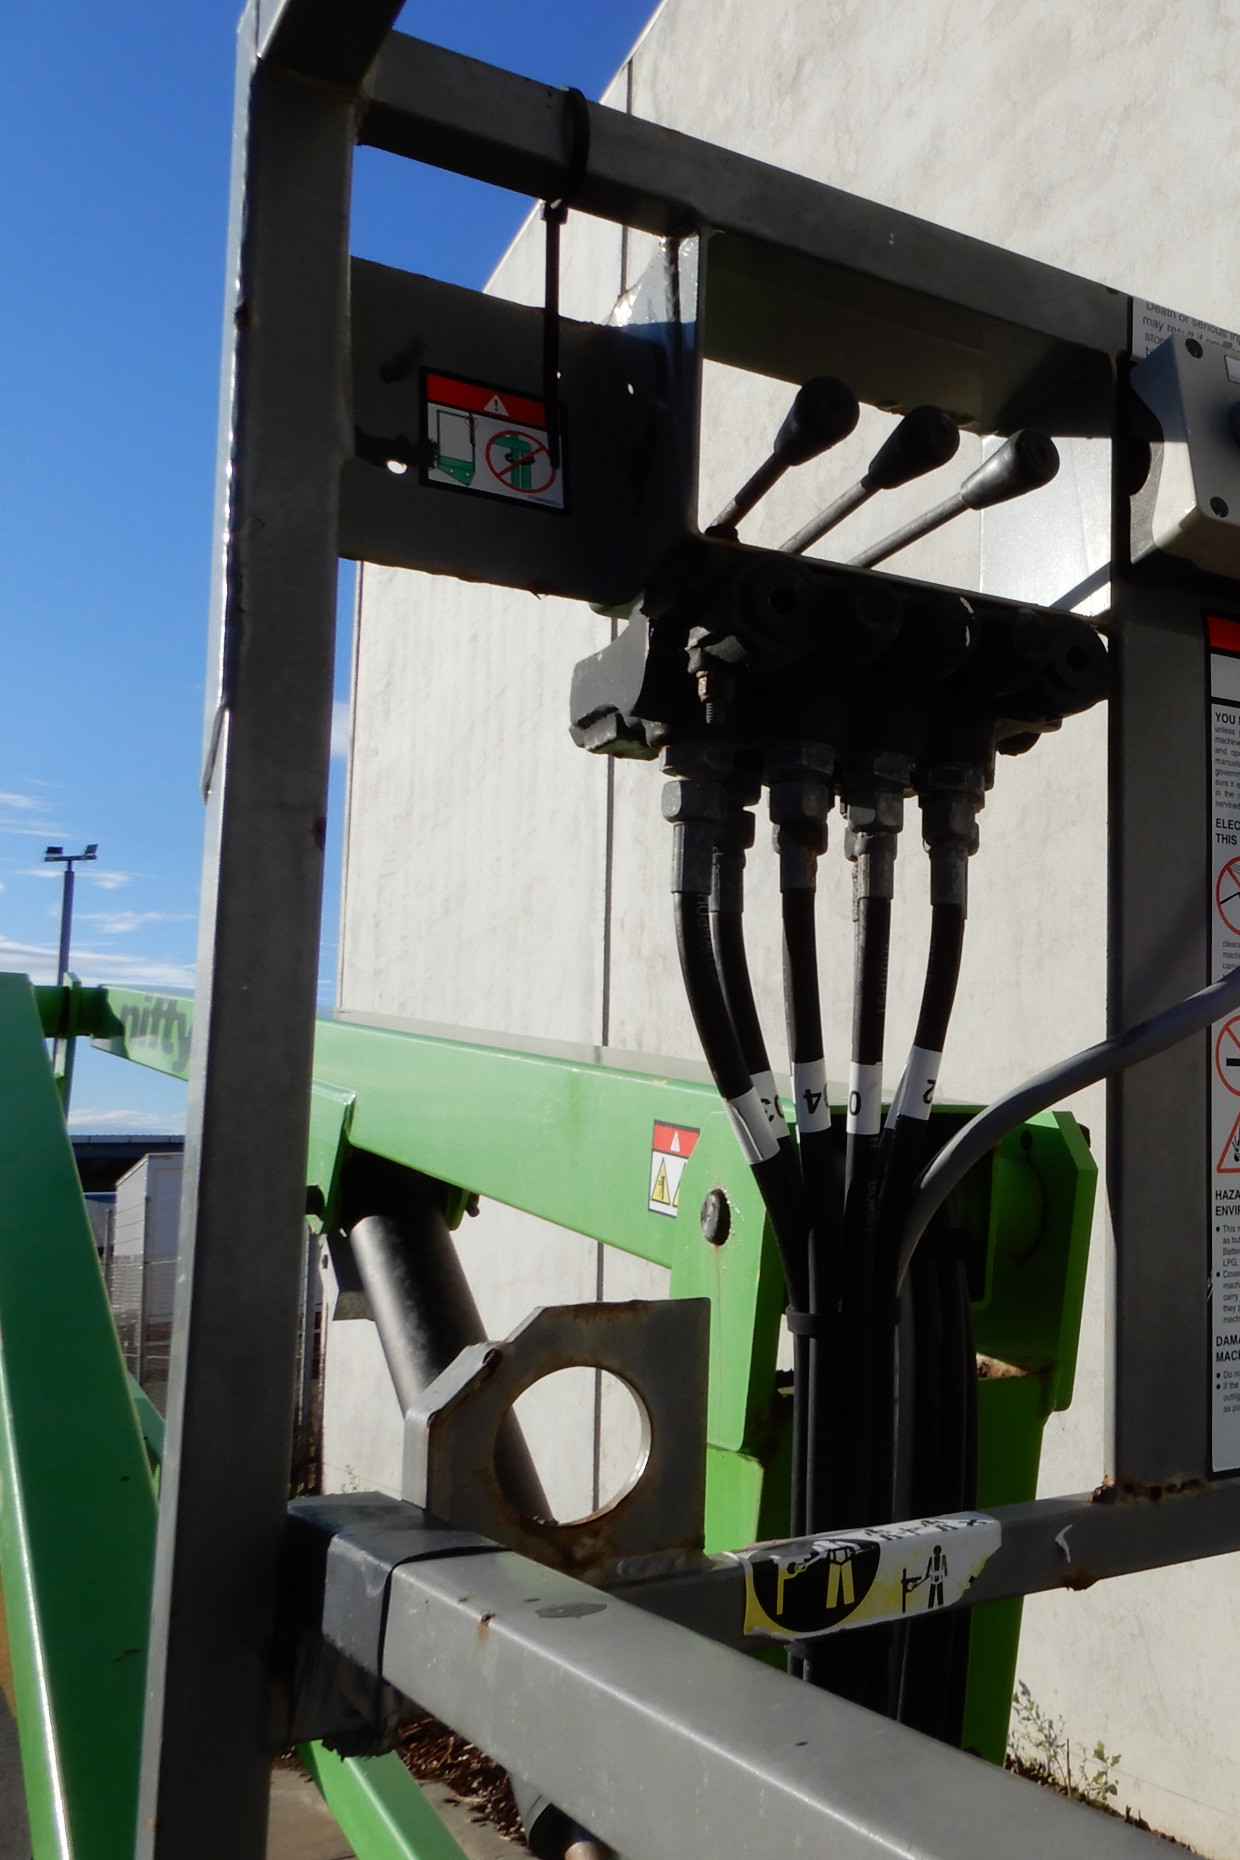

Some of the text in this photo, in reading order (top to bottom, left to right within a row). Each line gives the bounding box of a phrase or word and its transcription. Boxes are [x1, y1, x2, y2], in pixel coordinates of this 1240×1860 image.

[1142, 317, 1164, 332] may
[1214, 712, 1236, 725] YOU
[1215, 833, 1238, 846] THIS
